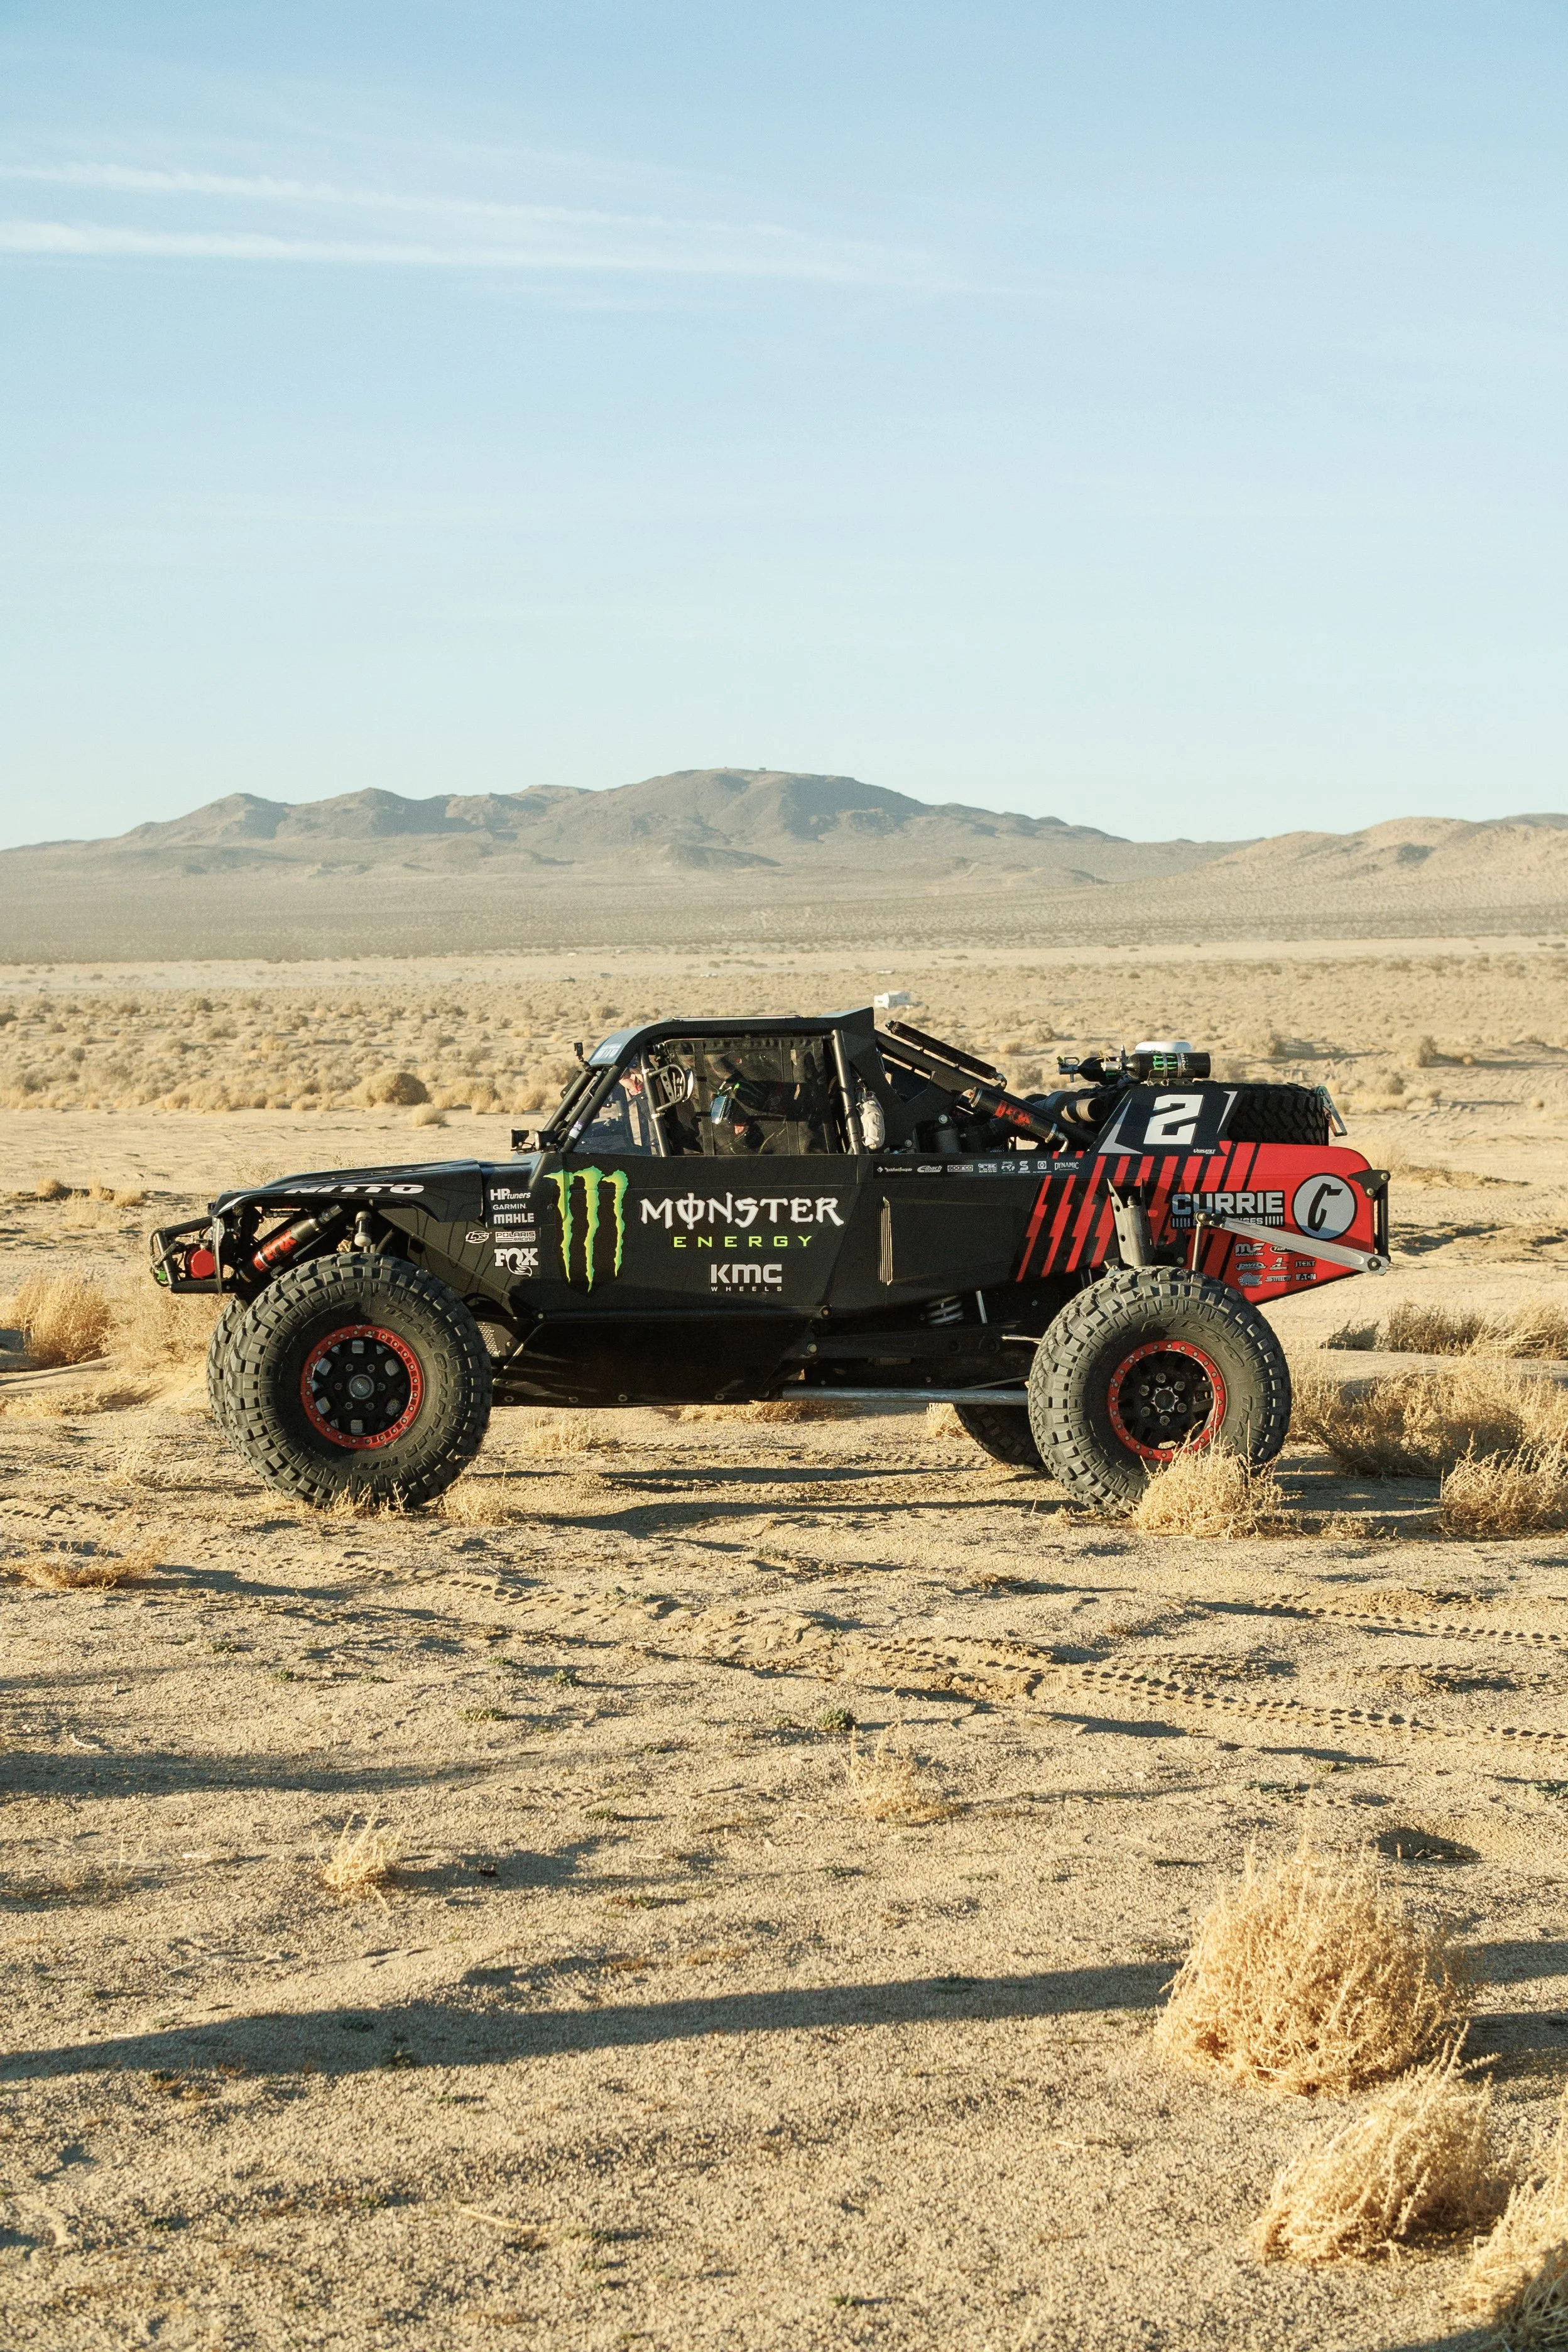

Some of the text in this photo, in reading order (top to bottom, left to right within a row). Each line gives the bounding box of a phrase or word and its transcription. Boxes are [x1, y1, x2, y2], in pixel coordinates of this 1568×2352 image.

[1143, 1094, 1204, 1145] 2
[1054, 1162, 1079, 1170] DYNAMIC
[284, 1184, 425, 1194] NITTO
[1172, 1192, 1284, 1215] CURRIE
[494, 1212, 535, 1224] MAHLE
[673, 1236, 812, 1248] ENERGY
[494, 1248, 538, 1277] FOX
